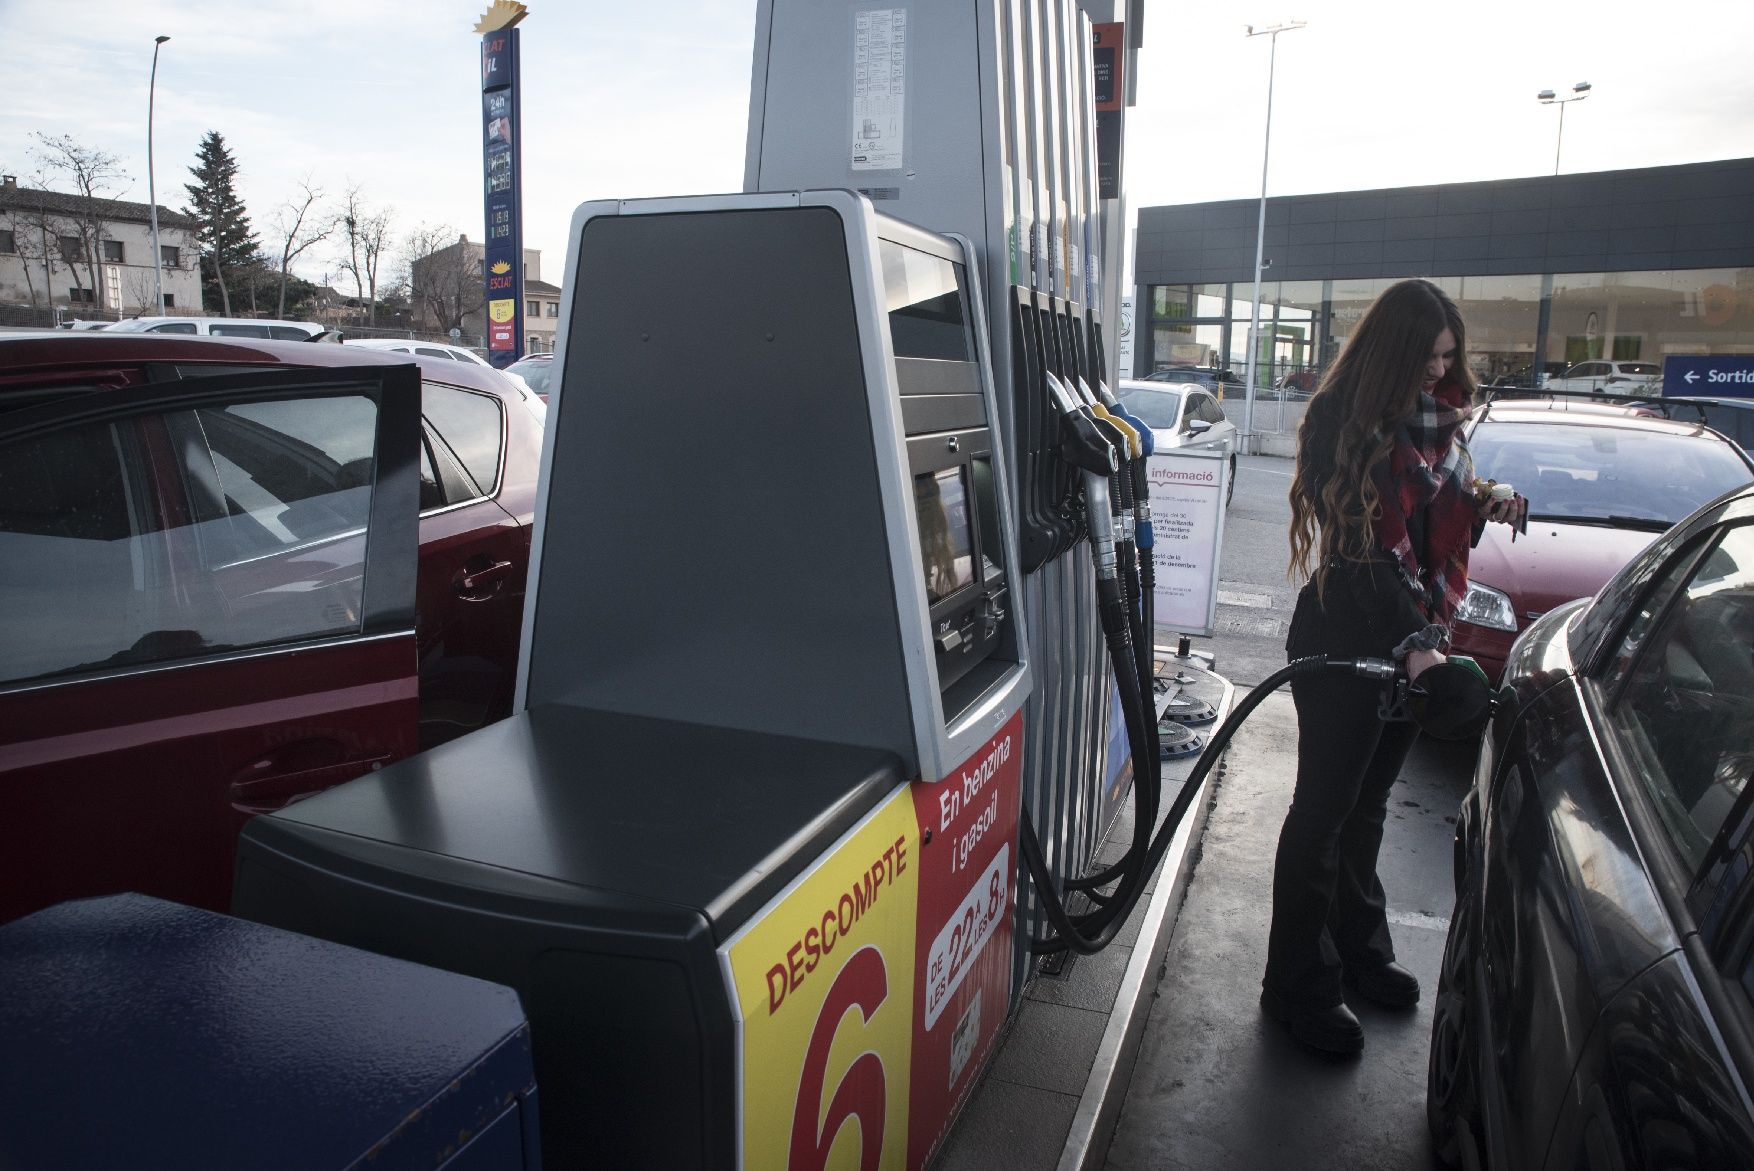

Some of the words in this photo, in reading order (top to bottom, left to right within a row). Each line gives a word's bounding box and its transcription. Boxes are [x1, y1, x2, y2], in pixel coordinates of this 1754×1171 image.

[490, 95, 505, 111] 24h
[489, 276, 513, 290] ESCLAT
[1151, 467, 1214, 481] informació
[939, 788, 960, 833] En
[962, 735, 1011, 807] benzina
[952, 837, 957, 874] i
[960, 788, 998, 870] gasoil
[975, 899, 981, 920] A
[987, 869, 1000, 923] 8
[766, 835, 907, 1016] DESCOMPTE
[974, 912, 988, 946] LES
[948, 906, 974, 988] 22
[930, 951, 944, 985] DE
[929, 979, 946, 1015] LES
[788, 944, 888, 1171] 6
